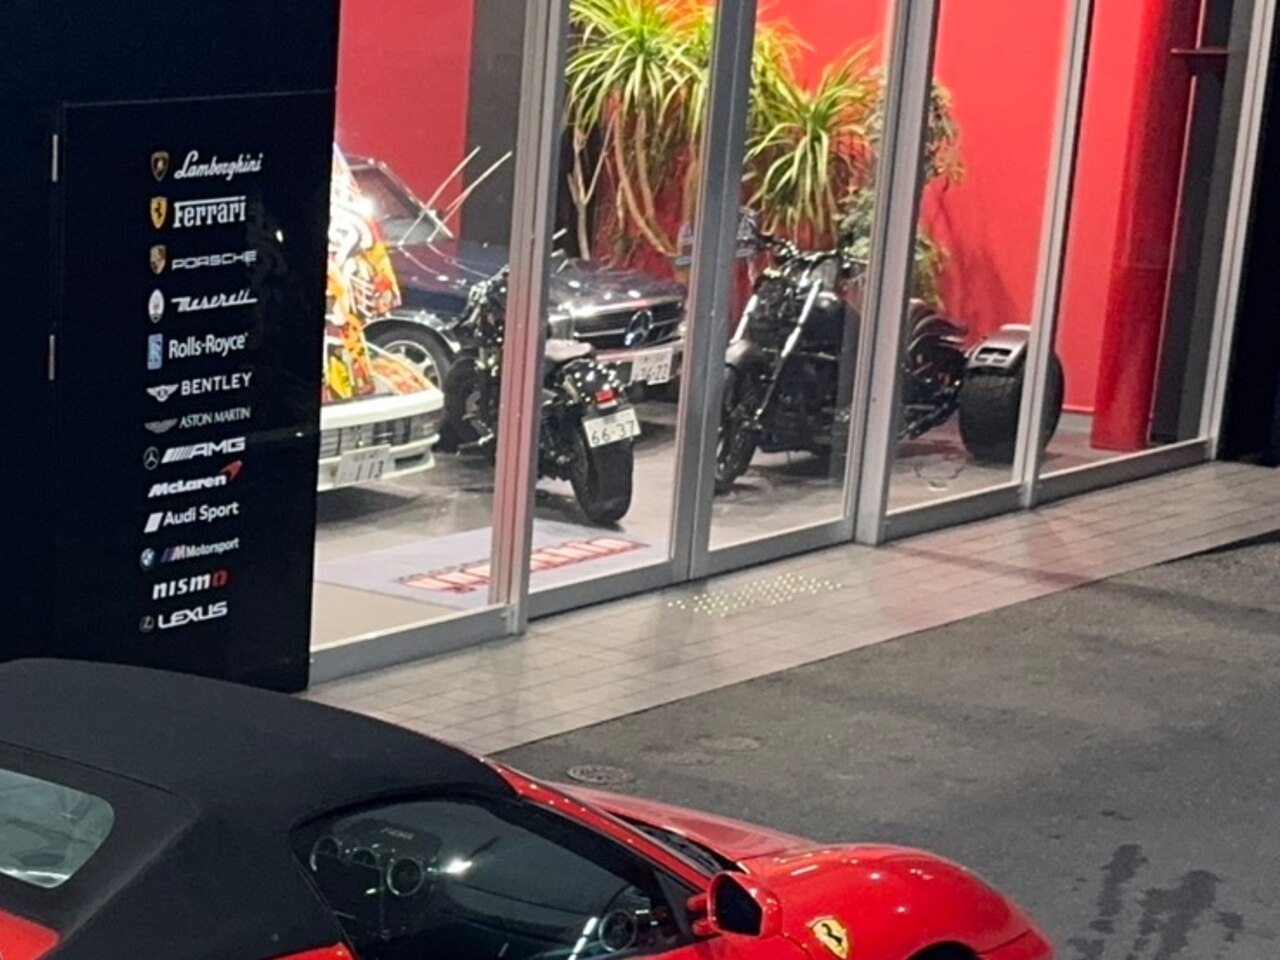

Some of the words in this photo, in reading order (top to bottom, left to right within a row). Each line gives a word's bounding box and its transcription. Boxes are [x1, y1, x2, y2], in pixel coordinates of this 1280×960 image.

[173, 149, 264, 182] Lamborghini
[172, 195, 247, 229] Ferrari
[171, 250, 257, 271] PORSCHE
[168, 332, 247, 359] Rolls-Royce
[180, 371, 253, 396] BENTLEY
[179, 411, 214, 430] ASTON
[214, 406, 252, 424] MARTIN
[591, 420, 636, 446] 66-37
[147, 474, 227, 499] McLaren
[162, 506, 197, 527] Audi
[198, 501, 241, 523] Sport
[157, 600, 228, 630] LEXUS
